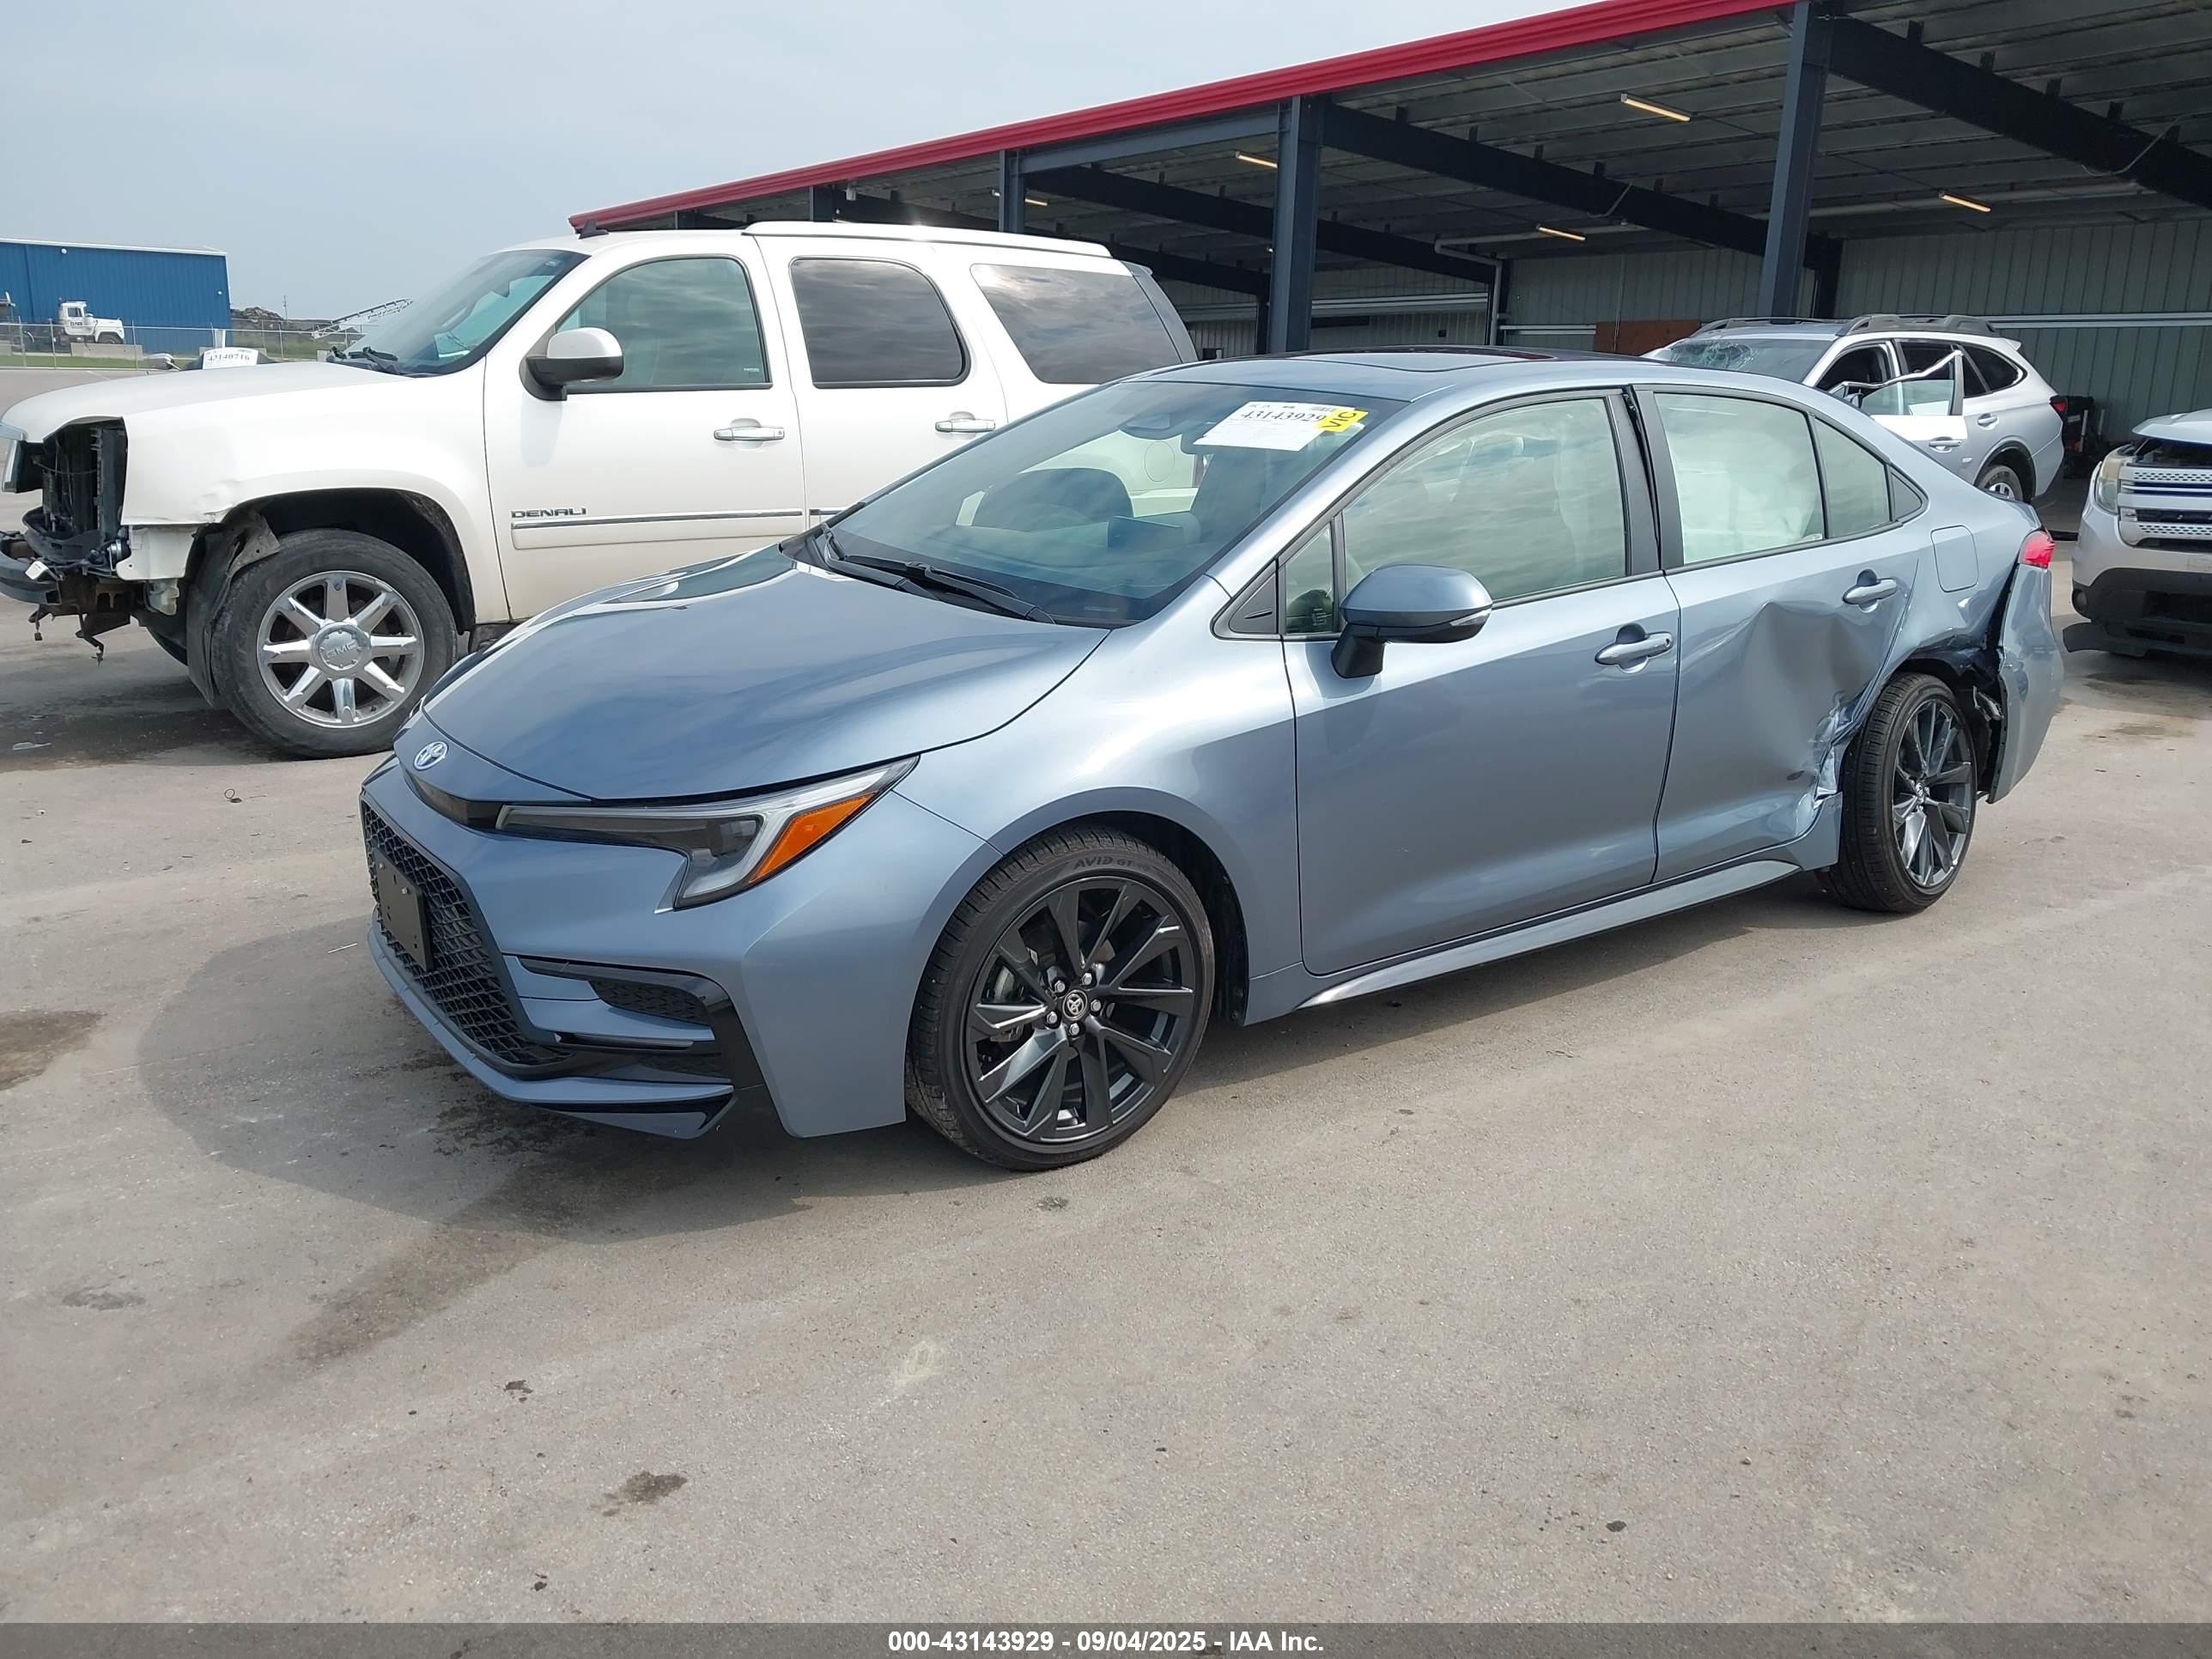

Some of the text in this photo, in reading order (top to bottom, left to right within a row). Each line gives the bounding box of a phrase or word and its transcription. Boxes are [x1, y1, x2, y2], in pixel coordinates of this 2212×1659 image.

[1241, 410, 1327, 422] 43143929
[1321, 411, 1358, 429] VIC
[510, 507, 587, 519] DENALI
[325, 639, 357, 659] GMC
[1073, 856, 1134, 870] AVID GT
